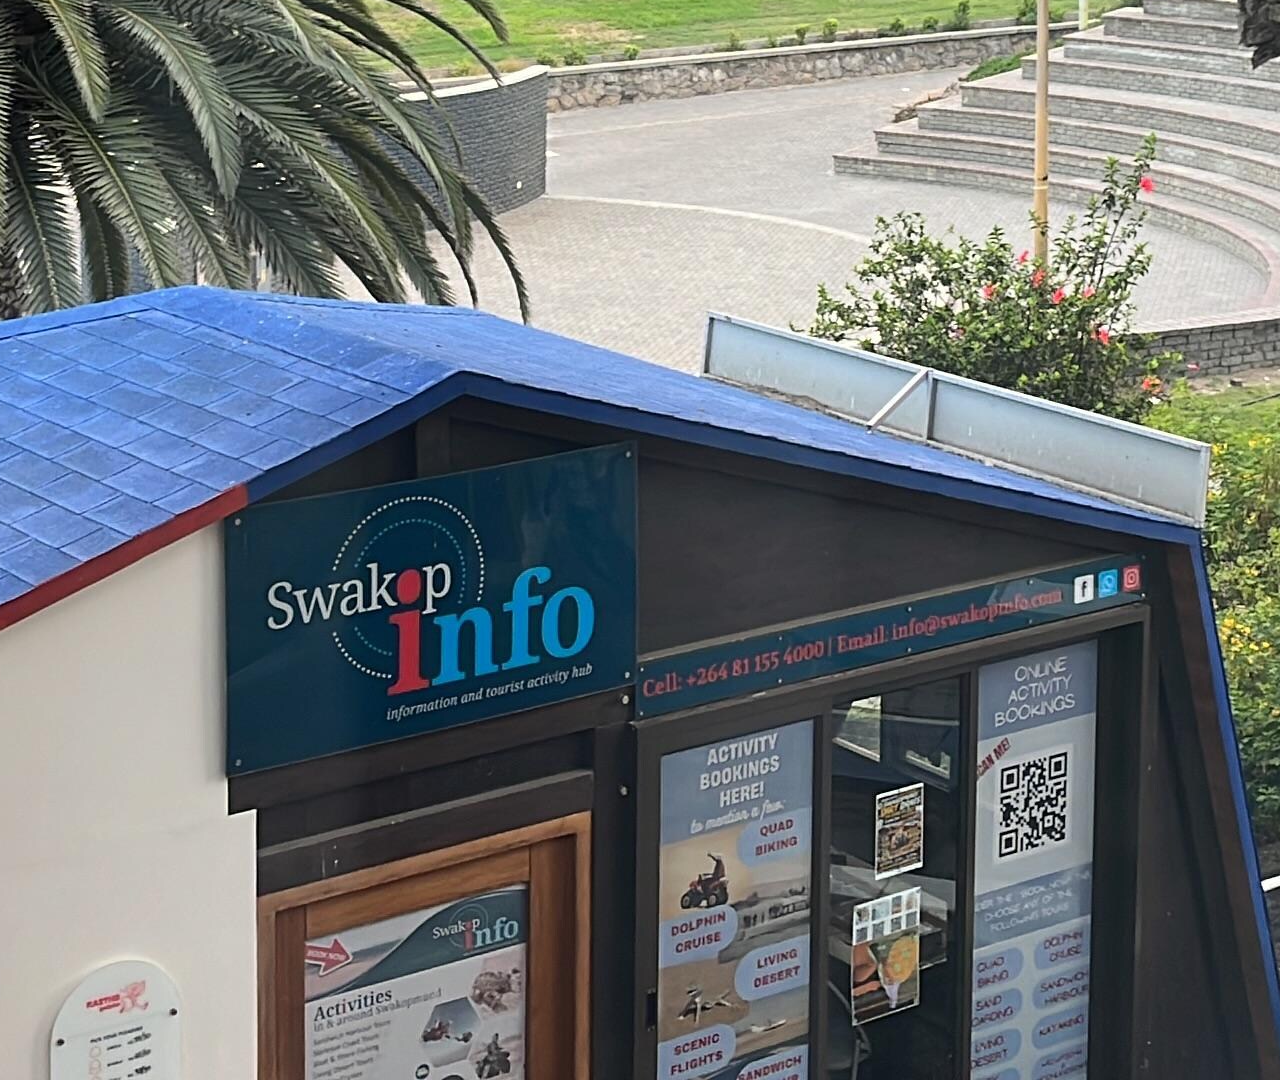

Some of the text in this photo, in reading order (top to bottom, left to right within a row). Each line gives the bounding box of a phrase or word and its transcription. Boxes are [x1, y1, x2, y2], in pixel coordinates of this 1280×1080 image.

[387, 566, 595, 696] info
[643, 672, 682, 698] Cell:
[687, 662, 728, 686] +264
[732, 658, 749, 675] 81
[754, 652, 779, 672] 155
[783, 641, 824, 665] 4000
[837, 625, 888, 653] Email:
[1014, 656, 1068, 682] ONLINE
[387, 663, 593, 722] information and tourist activity hub
[1008, 674, 1072, 704] ACTIVITY
[994, 694, 1076, 728] BOOKINGS
[707, 732, 778, 766] ACTIVITY
[977, 737, 1011, 777] CAN ME!
[700, 755, 780, 790] BOOKINGS
[720, 781, 764, 808] HERE!
[760, 819, 794, 837] QUAD
[755, 836, 798, 856] BIKING
[463, 916, 519, 950] info
[671, 912, 726, 936] DOLPHIN
[675, 932, 721, 953] CRUISE
[757, 949, 798, 968] LIVING
[753, 966, 800, 988] DESERT
[313, 989, 393, 1022] Activities
[975, 995, 1002, 1011] SAND
[336, 1007, 374, 1027] around
[674, 1033, 720, 1056] SCENIC
[671, 1051, 724, 1076] FLIGHTS
[737, 1055, 802, 1080] SANDWICH
